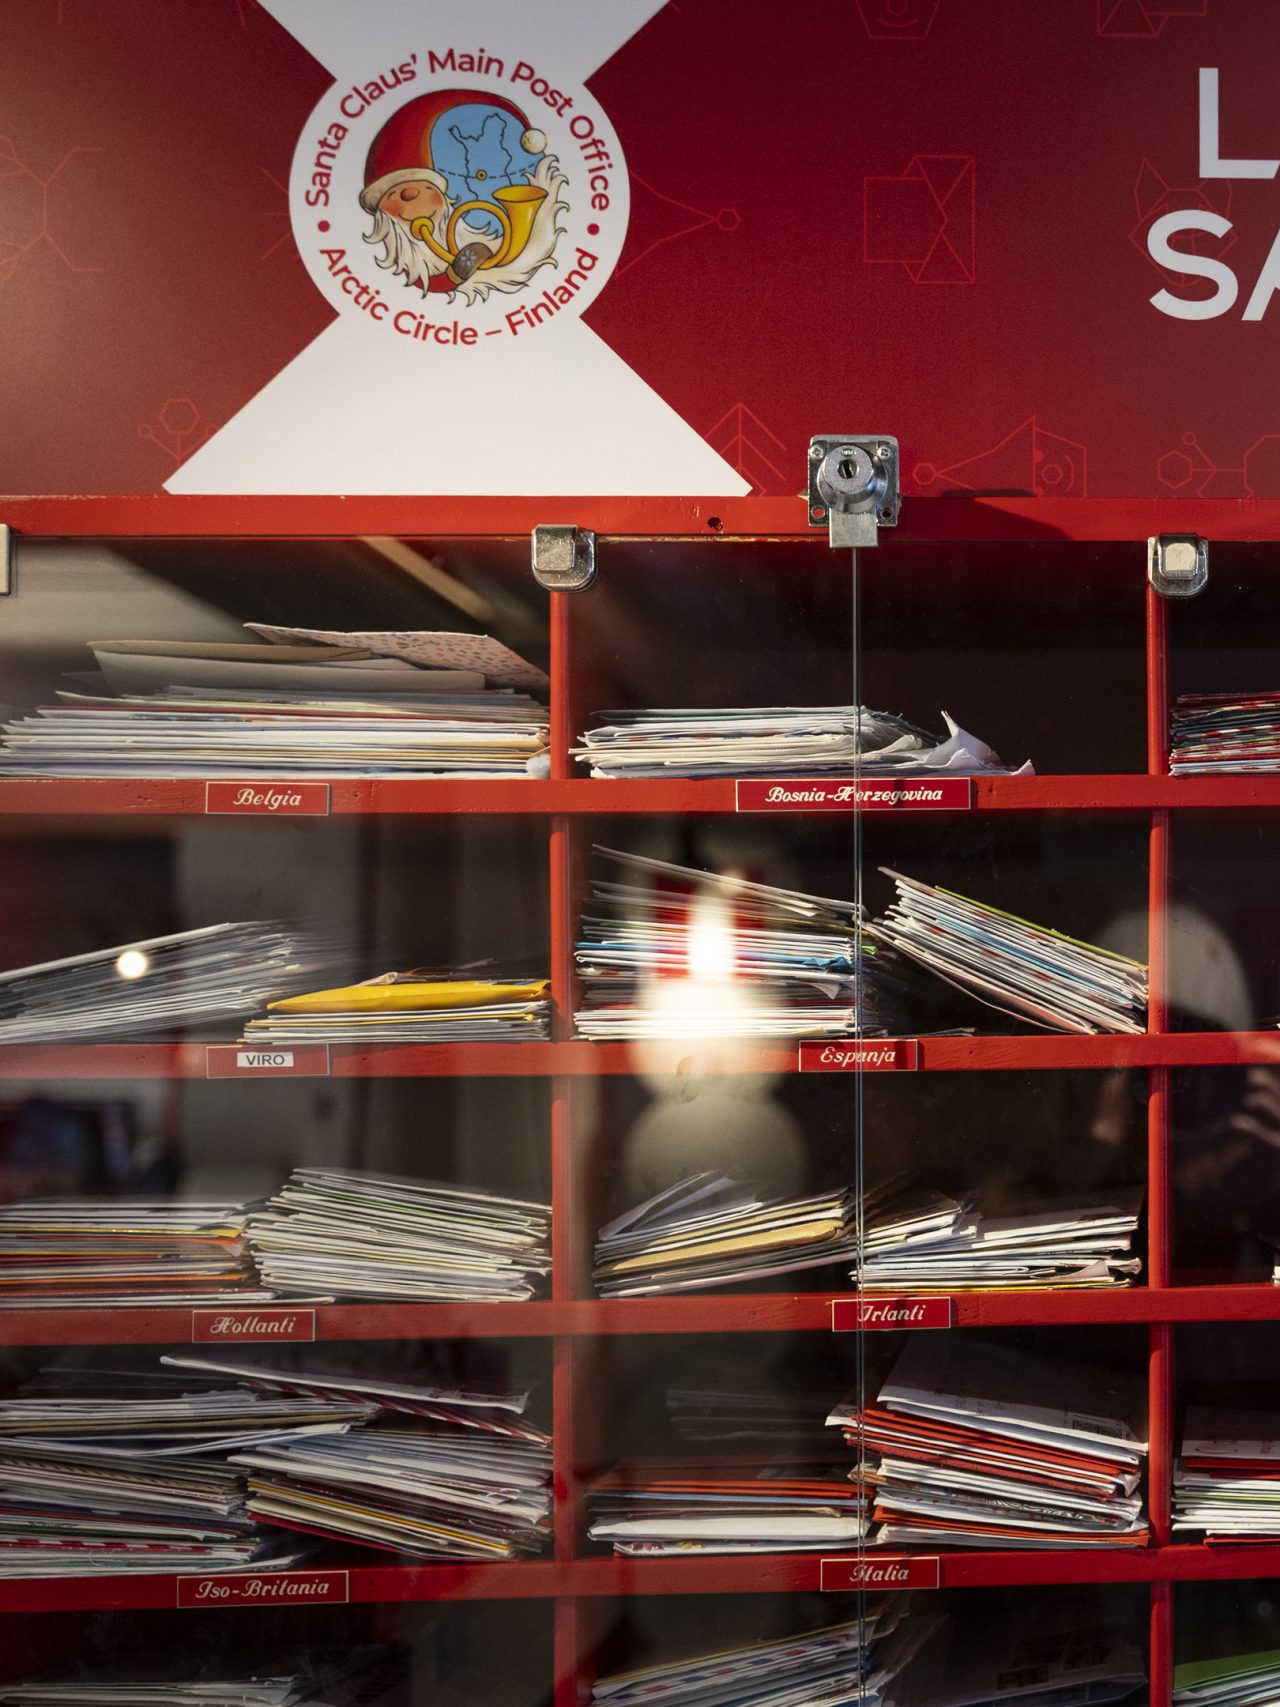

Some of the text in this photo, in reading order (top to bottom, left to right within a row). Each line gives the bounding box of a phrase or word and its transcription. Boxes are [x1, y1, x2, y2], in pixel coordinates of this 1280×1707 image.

[304, 119, 349, 208] Santa
[427, 48, 505, 78] Main
[509, 61, 575, 118] Post
[569, 115, 614, 211] Office
[319, 247, 390, 321] Arctic
[393, 310, 479, 347] Circle
[504, 247, 599, 337] Finland
[233, 788, 302, 810] Belgia
[765, 786, 943, 805] Bosnia-Herzegovina
[246, 1055, 285, 1066] VIRO
[820, 1046, 896, 1067] Espanja
[858, 1304, 927, 1322] Irlanti
[210, 1316, 297, 1334] Hollanti
[849, 1564, 910, 1582] Italia
[195, 1579, 330, 1599] Iso-Britania
